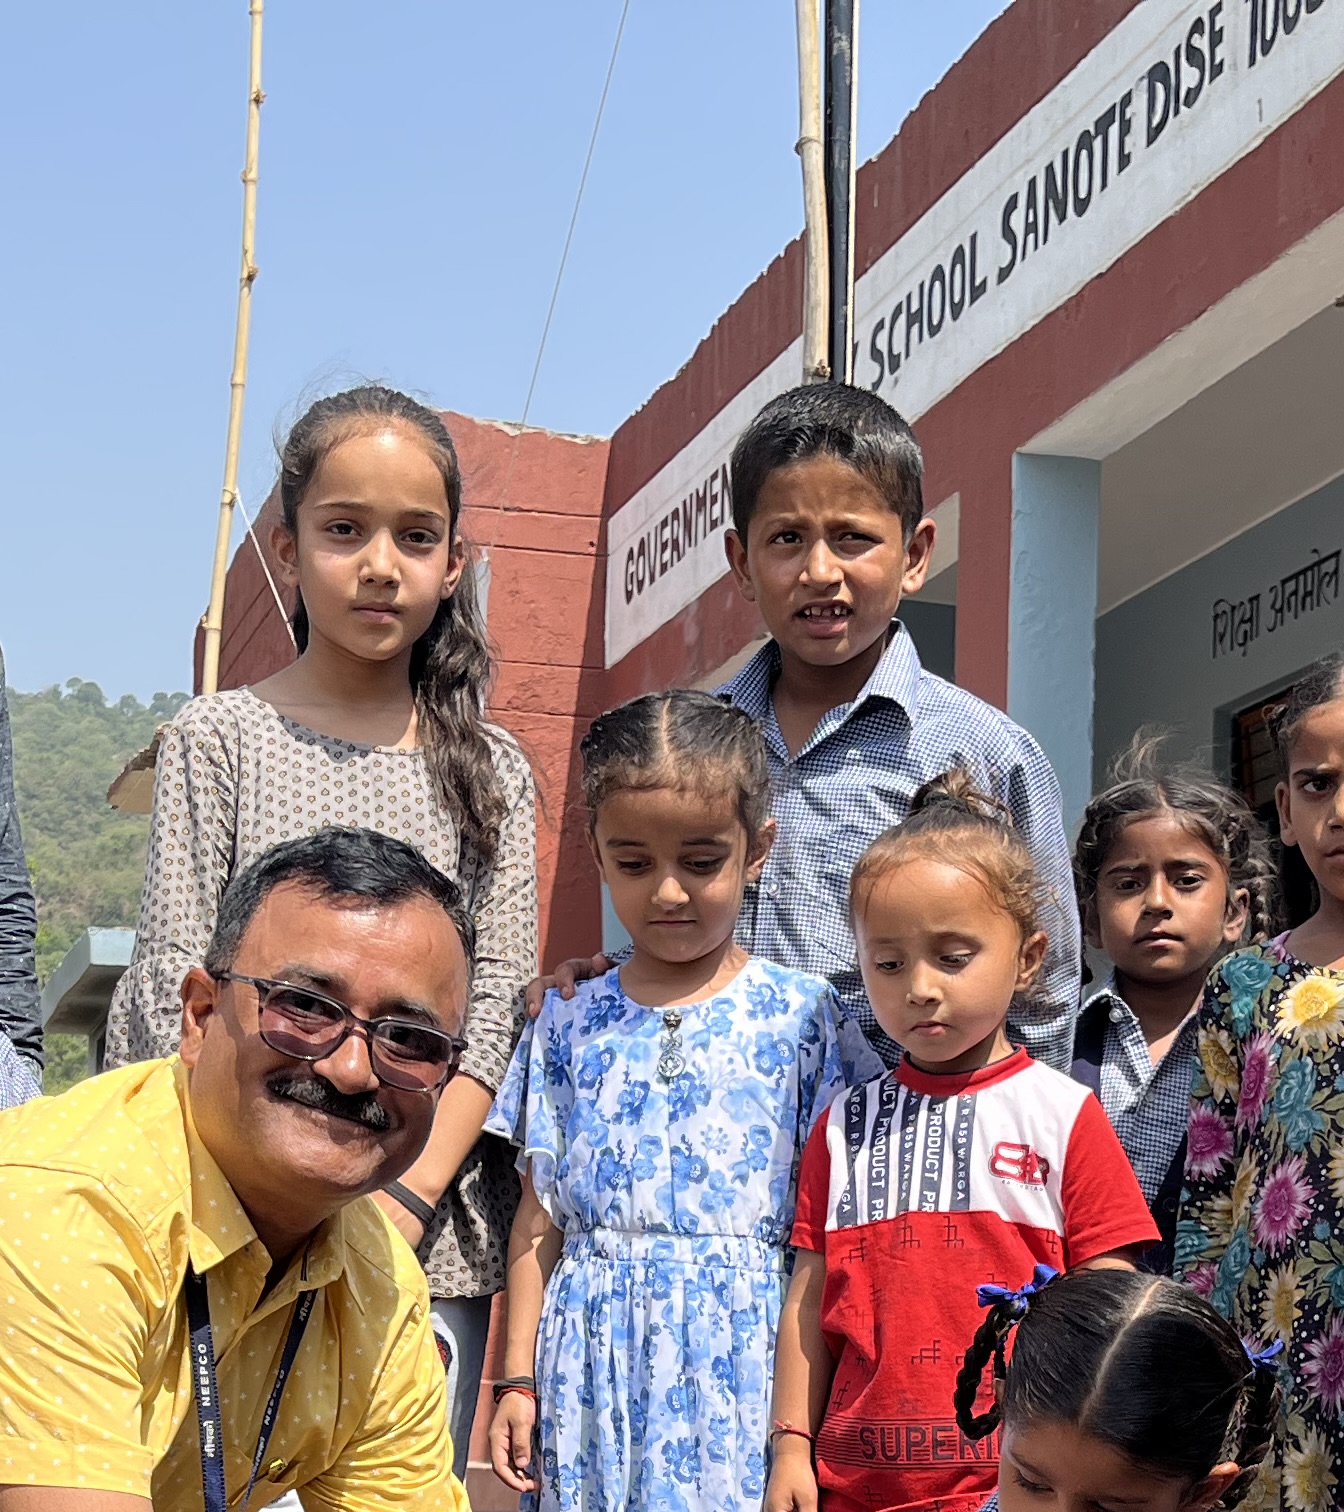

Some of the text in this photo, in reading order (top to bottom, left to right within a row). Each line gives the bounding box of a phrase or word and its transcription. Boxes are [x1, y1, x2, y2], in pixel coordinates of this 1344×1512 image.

[625, 463, 733, 604] GOVERNMEN
[869, 230, 987, 392] SCHOOL
[996, 88, 1132, 285] SANOTE
[1145, 0, 1224, 149] DISE
[1212, 593, 1262, 659] शिक्षा
[1267, 549, 1343, 632] अनमोल
[872, 1117, 892, 1189] PRODUCT
[924, 1103, 944, 1181] PRODUCT
[957, 1147, 966, 1200] WARGA
[198, 1343, 212, 1407] NEEPCO
